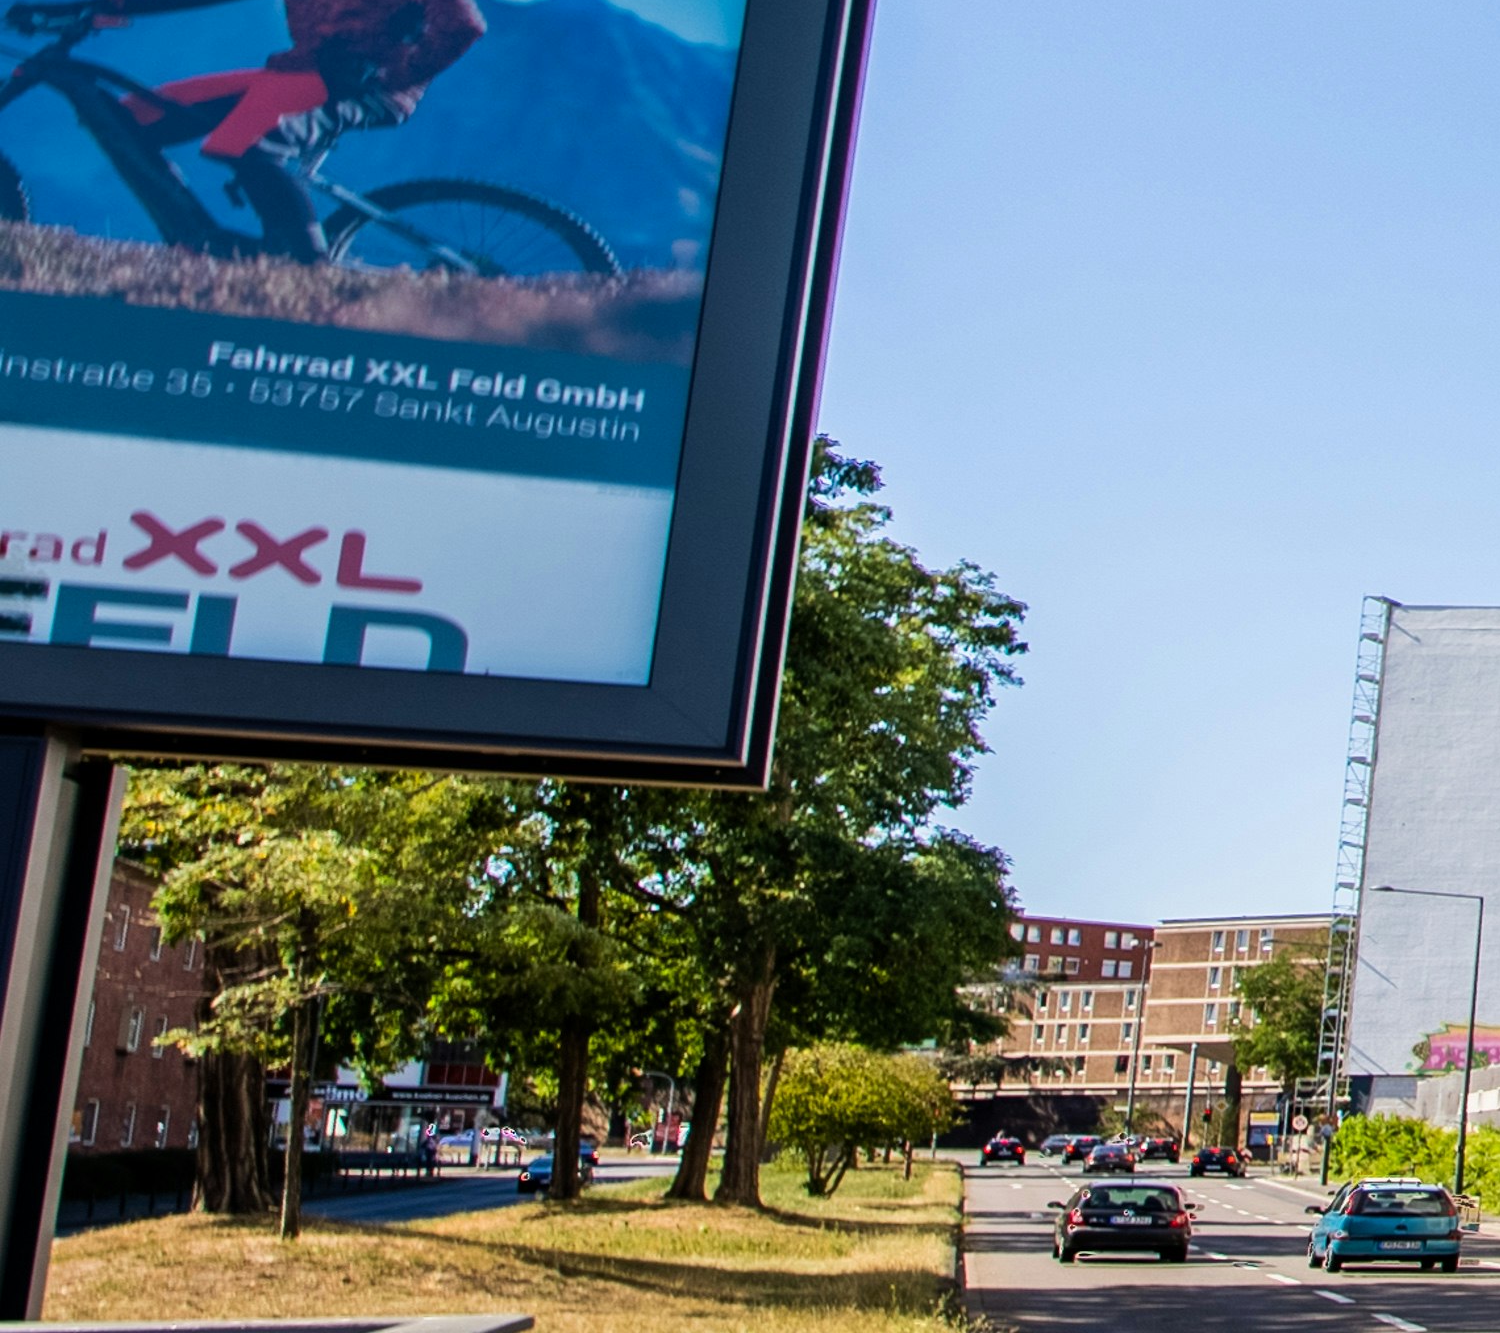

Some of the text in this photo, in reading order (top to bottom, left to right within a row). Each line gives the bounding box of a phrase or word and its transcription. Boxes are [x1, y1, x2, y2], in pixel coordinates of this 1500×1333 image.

[164, 367, 213, 399] 35
[249, 376, 365, 413] 53757
[373, 389, 477, 428] Sankt
[485, 403, 641, 443] Augustin
[208, 340, 646, 413] Fahrrad XXL Feld GmbH
[121, 508, 424, 595] XXL
